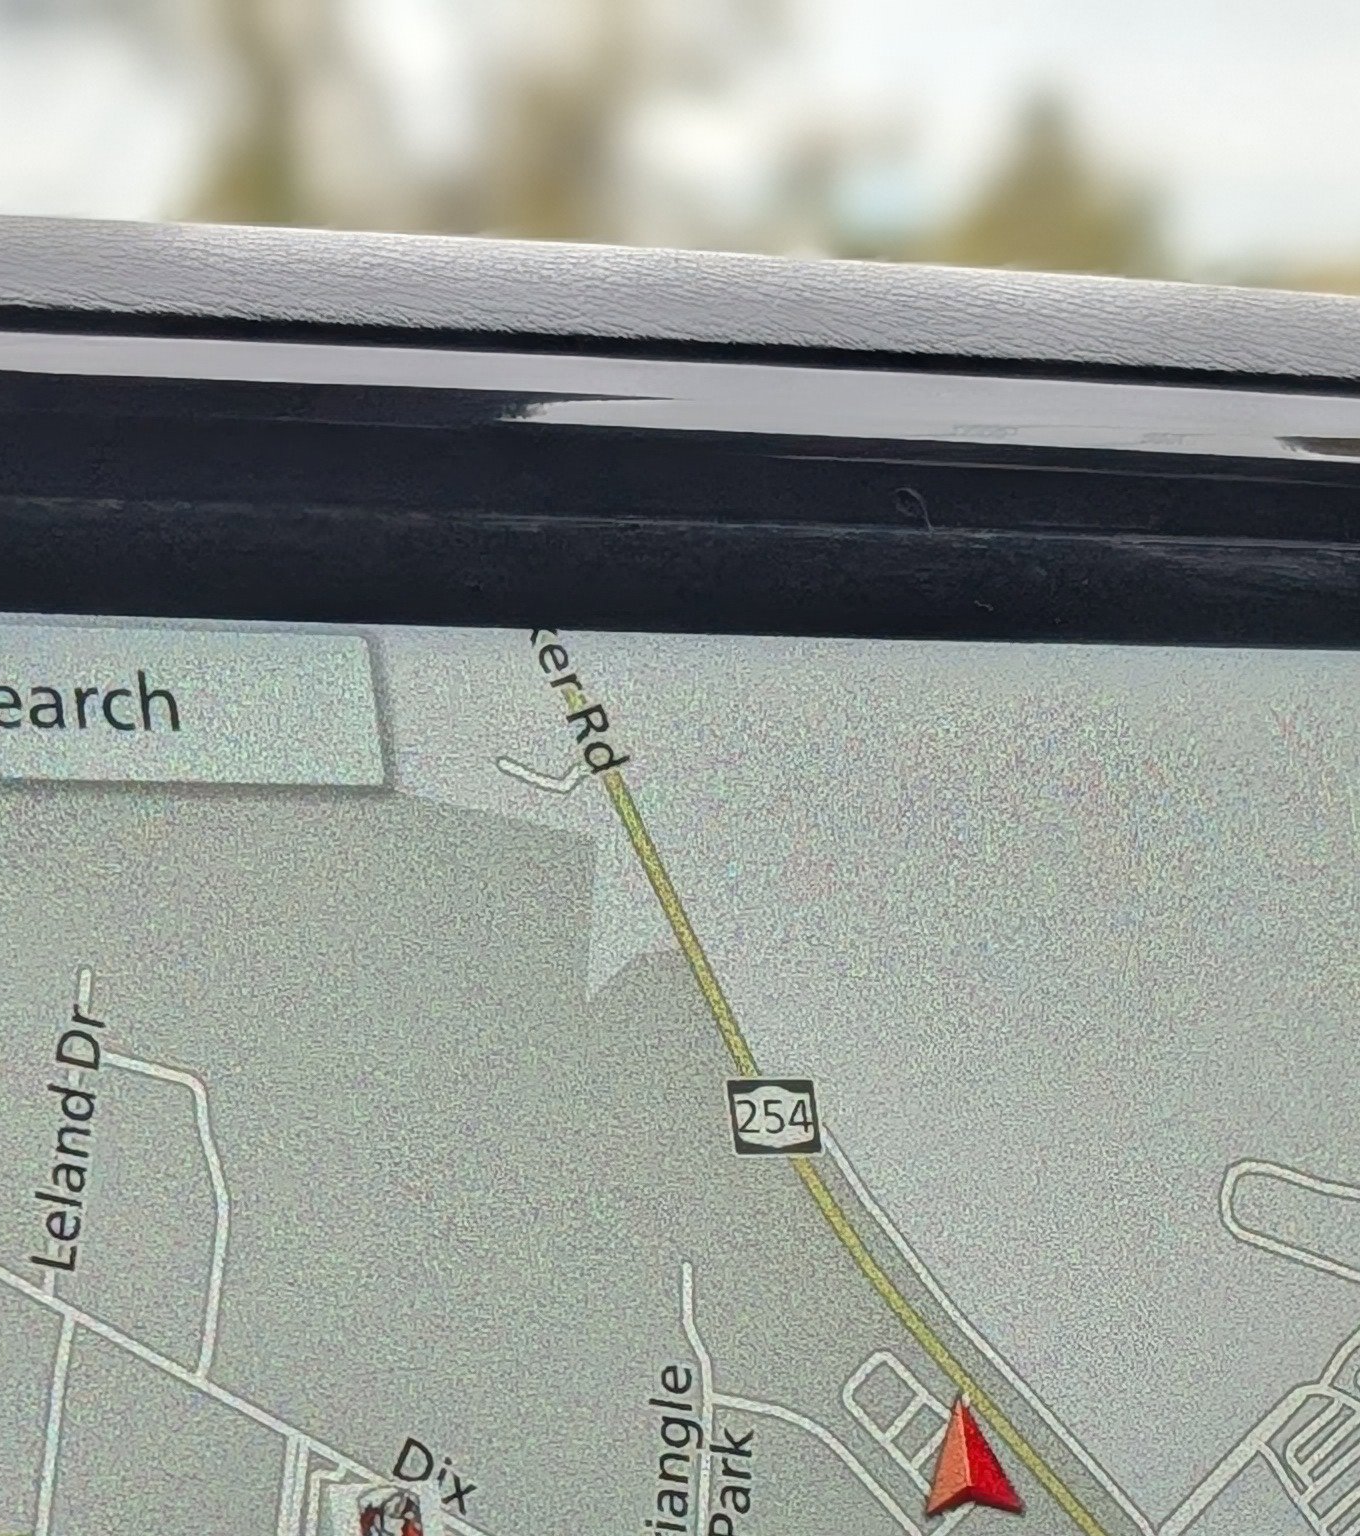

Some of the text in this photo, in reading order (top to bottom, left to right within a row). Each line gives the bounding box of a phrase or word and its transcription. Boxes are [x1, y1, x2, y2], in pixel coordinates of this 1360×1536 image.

[565, 703, 631, 775] Rd
[30, 1004, 108, 1272] Leland Dr
[736, 1096, 814, 1138] 254
[392, 1436, 478, 1516] Dix
